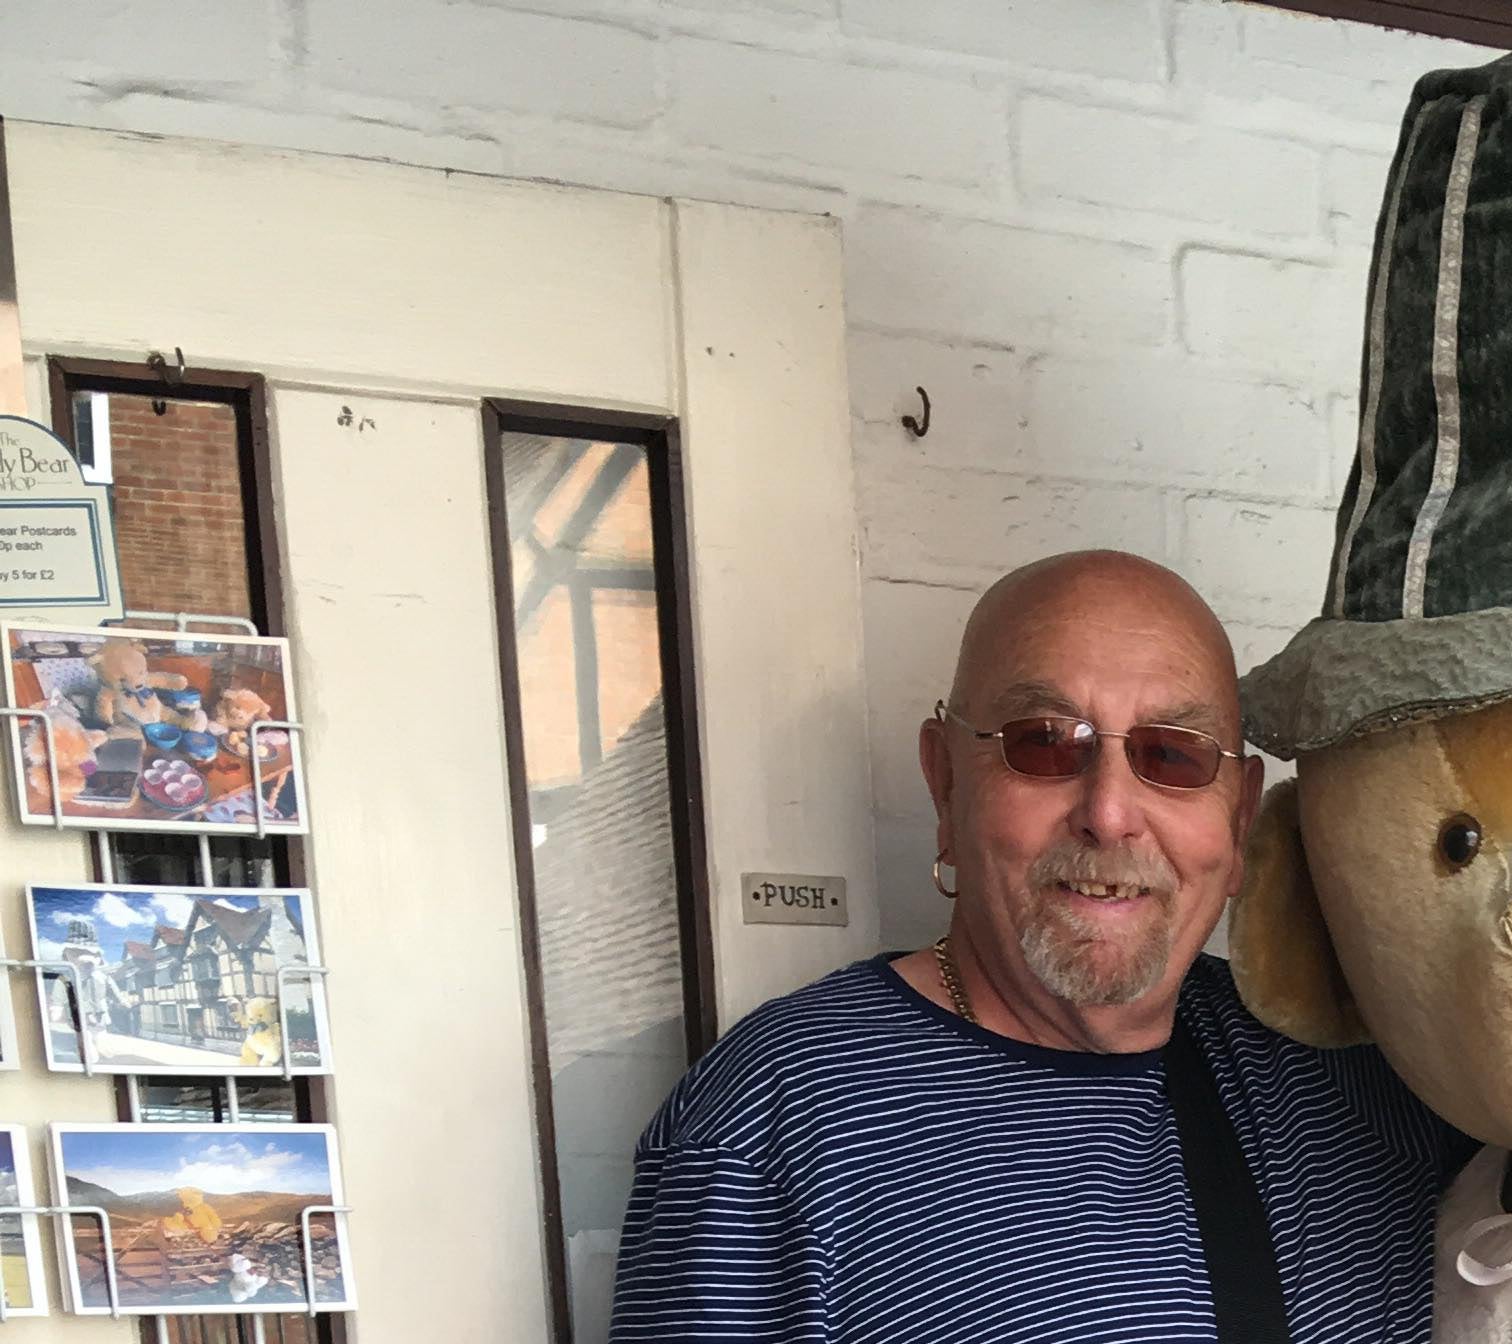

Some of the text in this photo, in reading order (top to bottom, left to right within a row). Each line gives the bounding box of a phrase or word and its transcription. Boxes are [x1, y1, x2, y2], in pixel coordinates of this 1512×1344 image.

[19, 447, 69, 473] Bear
[20, 525, 77, 536] Postcards
[15, 541, 43, 551] each
[12, 570, 20, 580] 5
[22, 570, 37, 580] for
[40, 570, 55, 580] £2
[760, 881, 826, 909] PUSH
